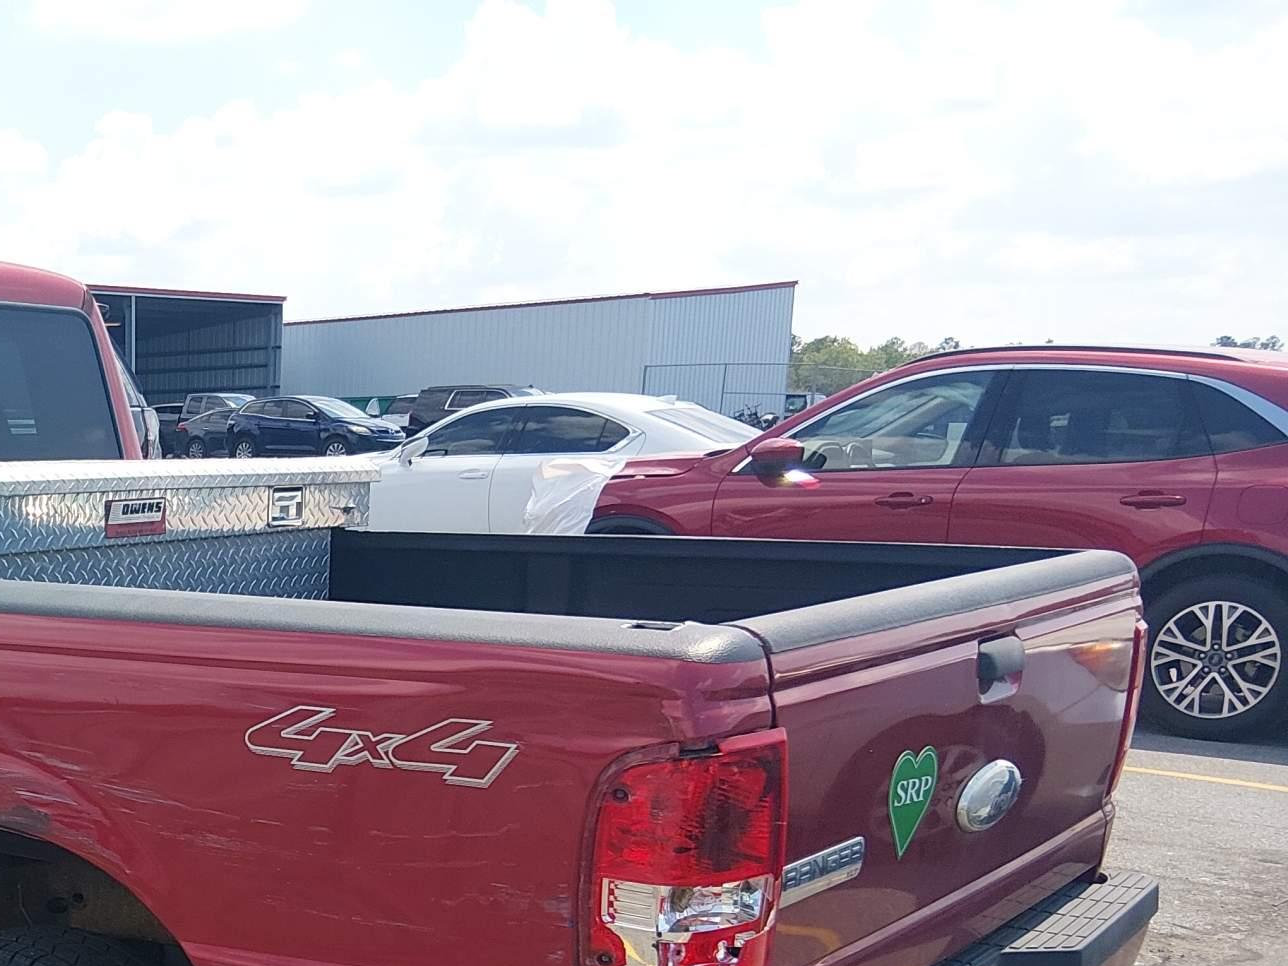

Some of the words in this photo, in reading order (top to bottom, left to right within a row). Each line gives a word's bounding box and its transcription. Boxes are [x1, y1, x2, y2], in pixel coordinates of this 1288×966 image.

[121, 501, 163, 516] OWENS
[245, 705, 519, 789] 4x4
[893, 775, 933, 808] SRP
[783, 841, 863, 892] RANGER
